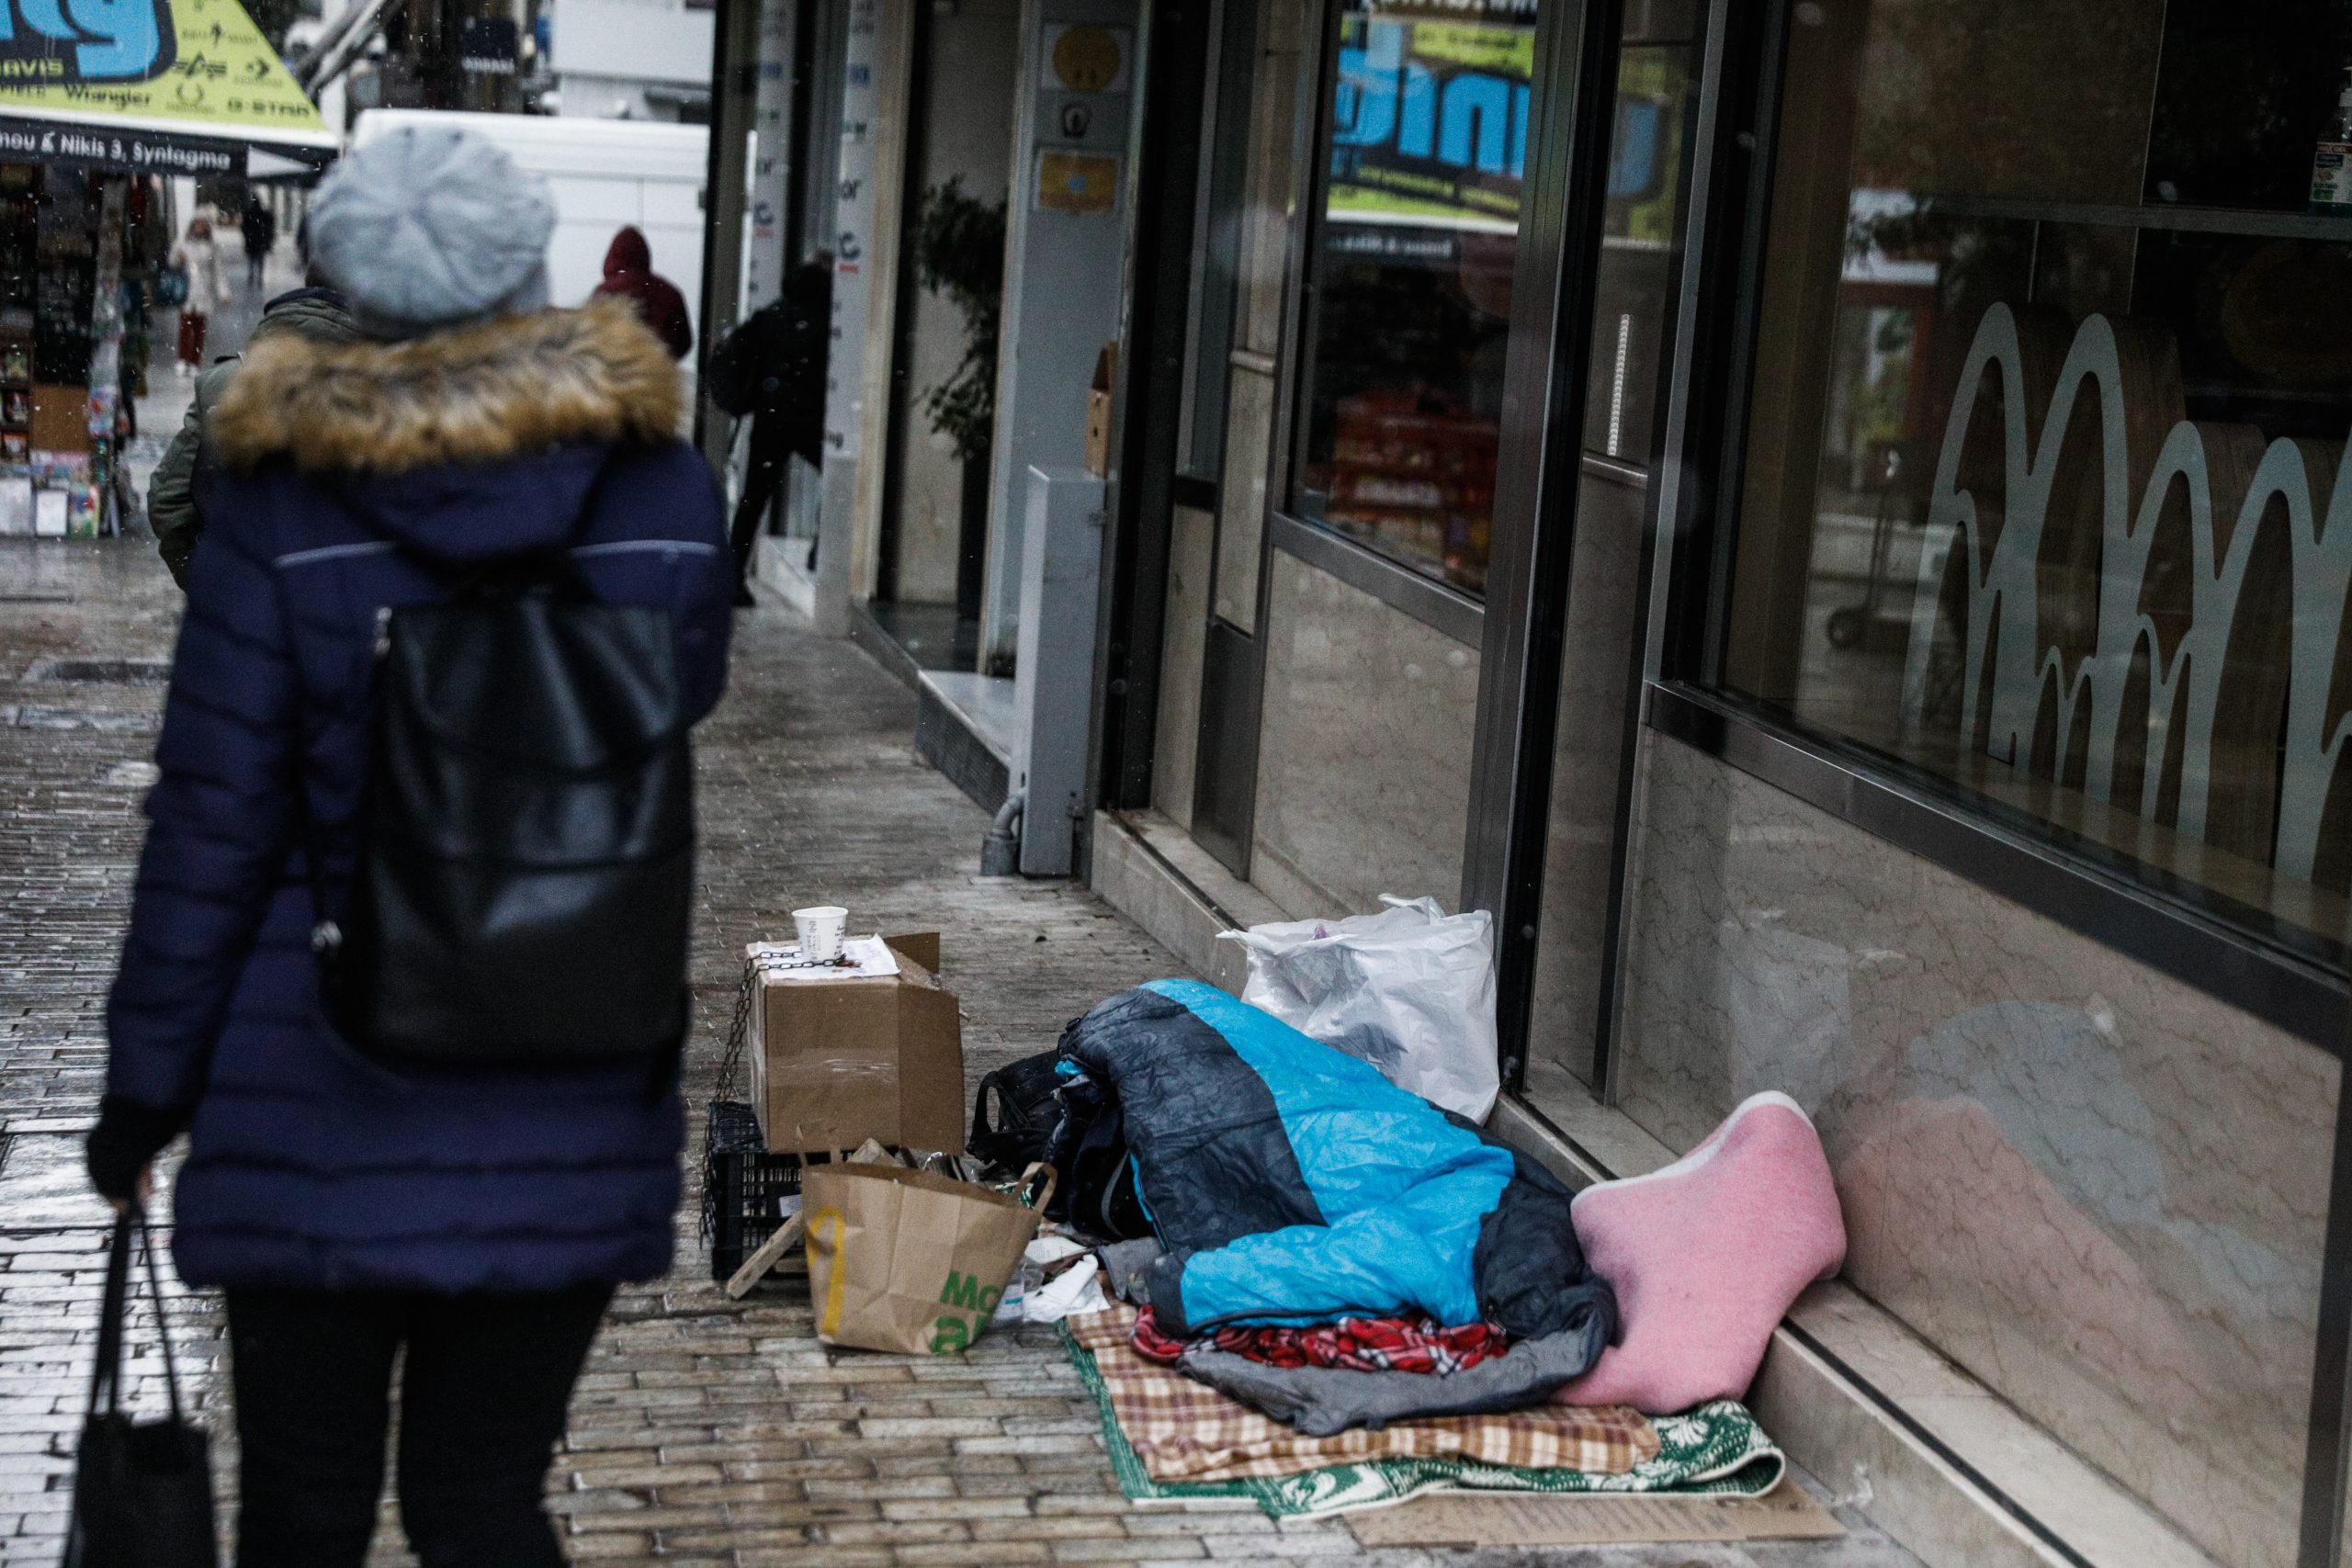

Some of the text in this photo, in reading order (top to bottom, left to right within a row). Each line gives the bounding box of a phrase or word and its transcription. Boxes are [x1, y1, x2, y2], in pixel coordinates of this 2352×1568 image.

[0, 58, 64, 77] AVIS
[64, 83, 151, 111] Wrangler
[40, 130, 56, 153] &
[61, 133, 106, 158] Nikis
[133, 141, 231, 171] Syntagma
